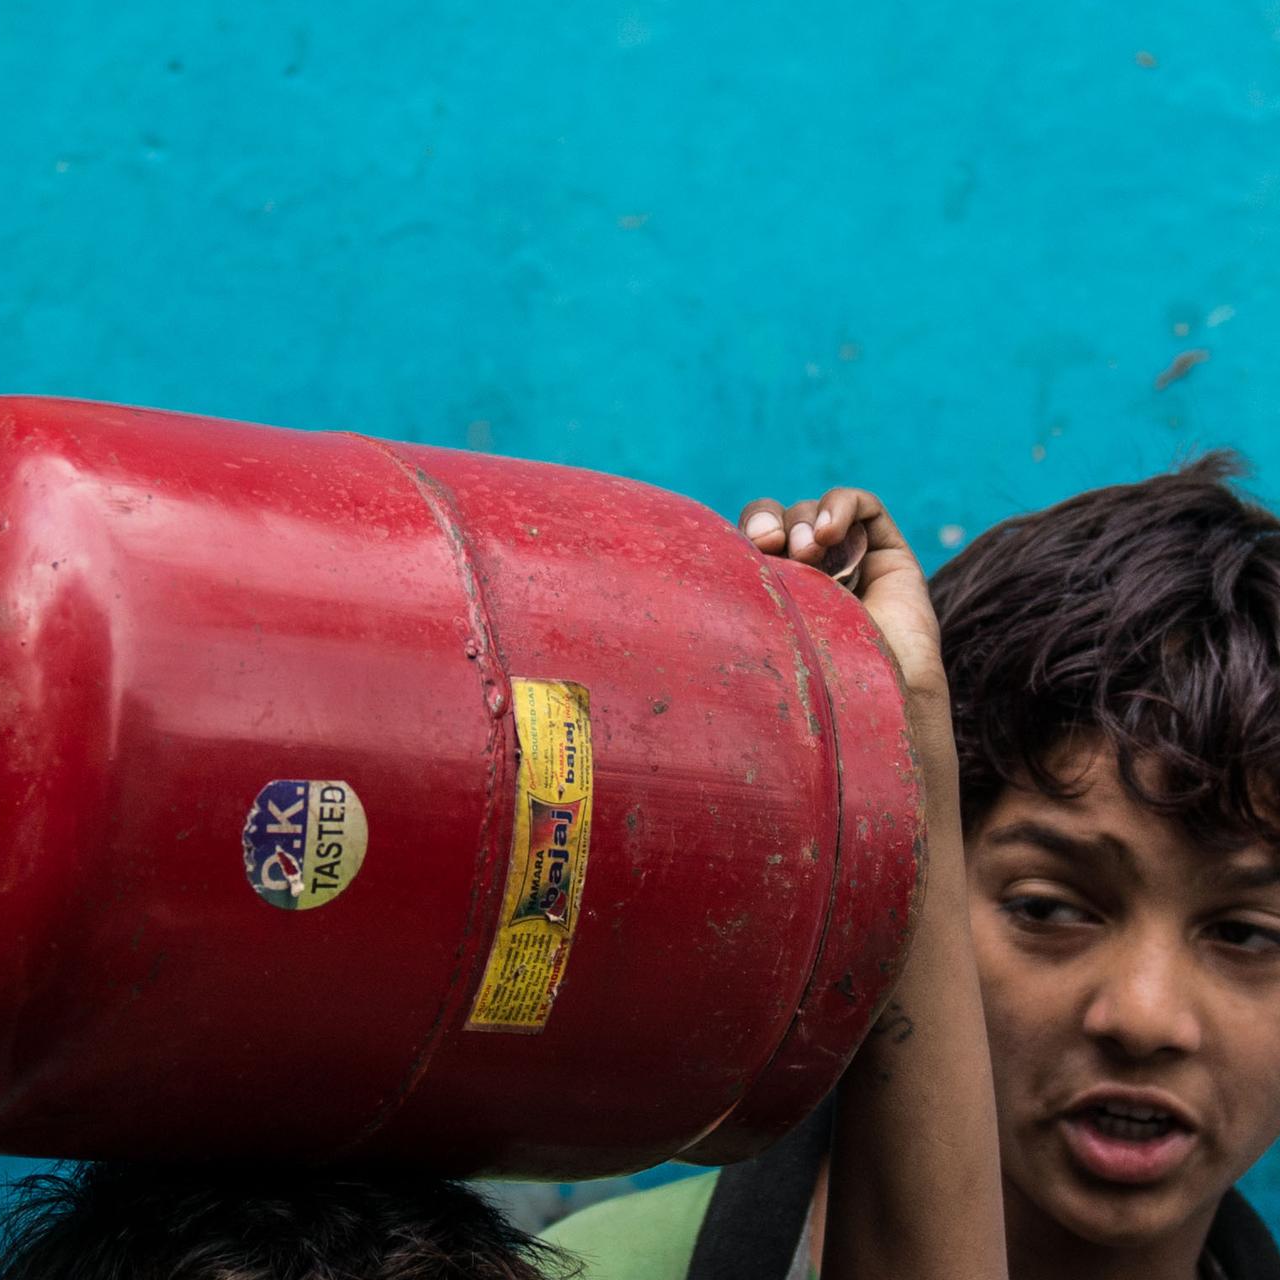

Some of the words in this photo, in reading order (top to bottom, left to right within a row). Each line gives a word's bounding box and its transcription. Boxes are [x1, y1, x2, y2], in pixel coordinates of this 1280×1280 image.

[563, 721, 576, 783] bajaj
[311, 785, 346, 894] TASTED
[527, 849, 544, 911] HAMARA
[538, 808, 575, 911] bajaj
